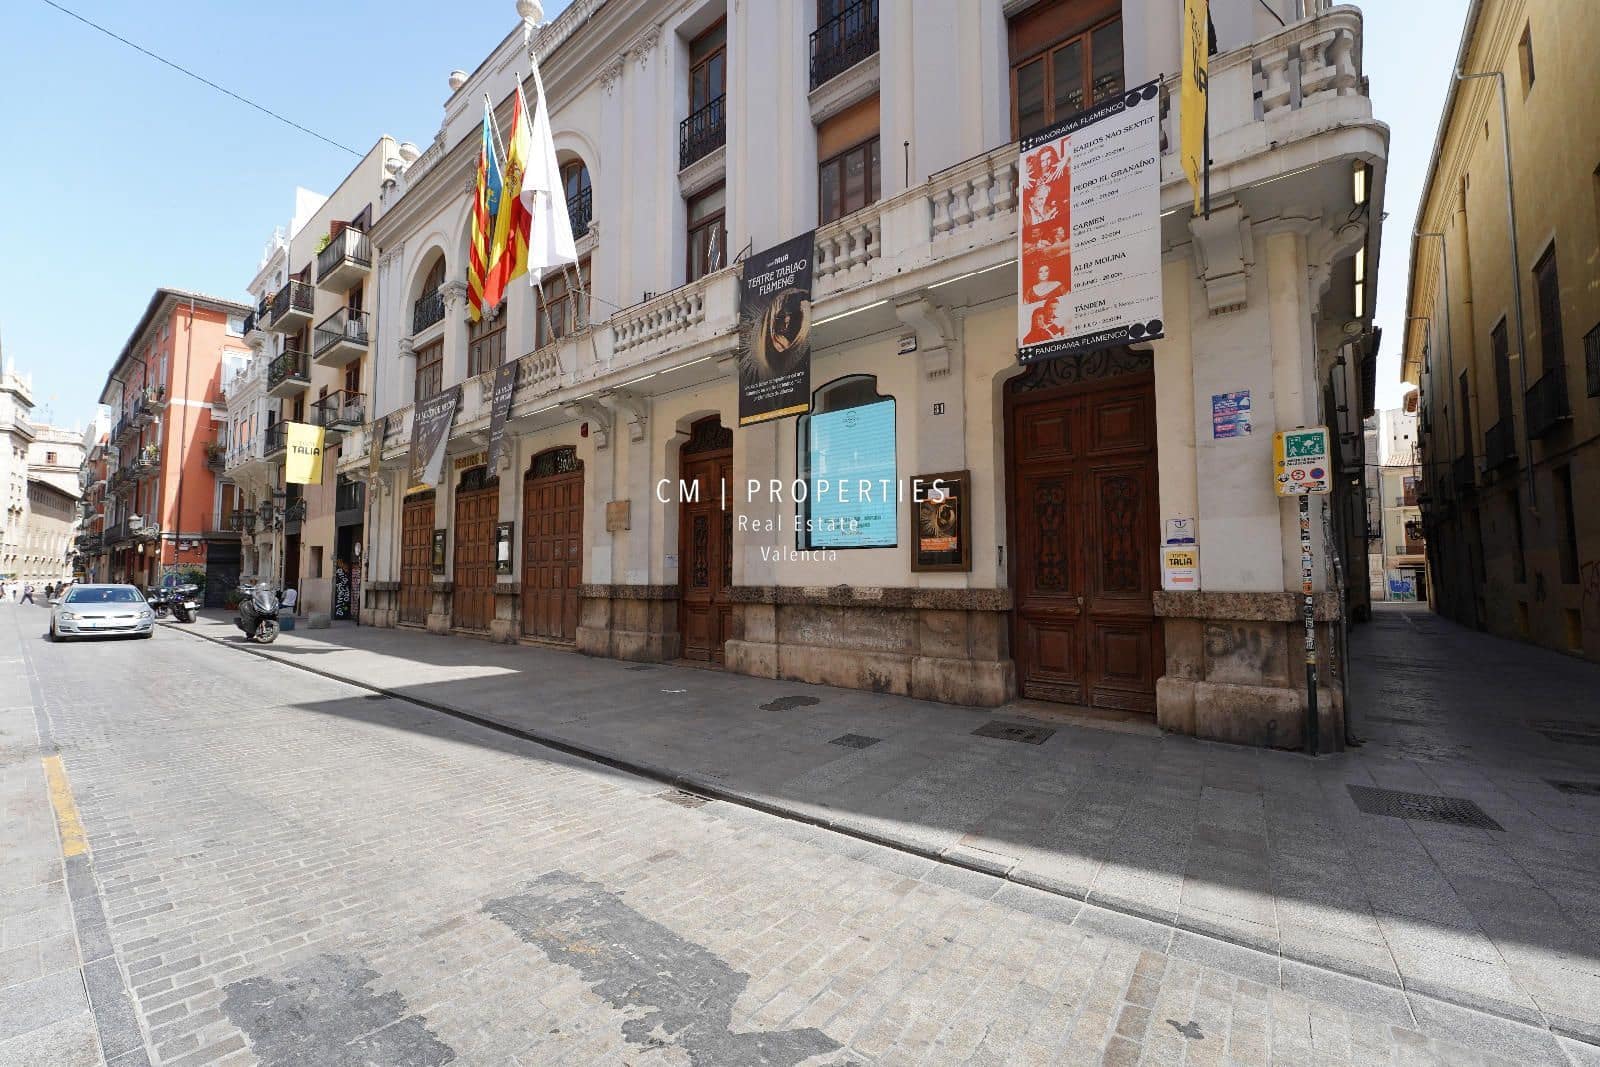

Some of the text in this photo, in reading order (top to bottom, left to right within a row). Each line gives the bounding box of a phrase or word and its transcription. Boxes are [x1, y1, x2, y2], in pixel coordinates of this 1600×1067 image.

[1035, 101, 1125, 144] PANORAMA FLAMENCO
[1073, 178, 1098, 192] PEDRO
[1099, 174, 1108, 183] EL
[1073, 216, 1105, 231] CARMEN
[1095, 252, 1127, 266] MOLINA
[748, 272, 775, 289] TEATRE
[1035, 329, 1128, 355] PANORAMA FLAMENCO
[291, 446, 320, 457] TALIA
